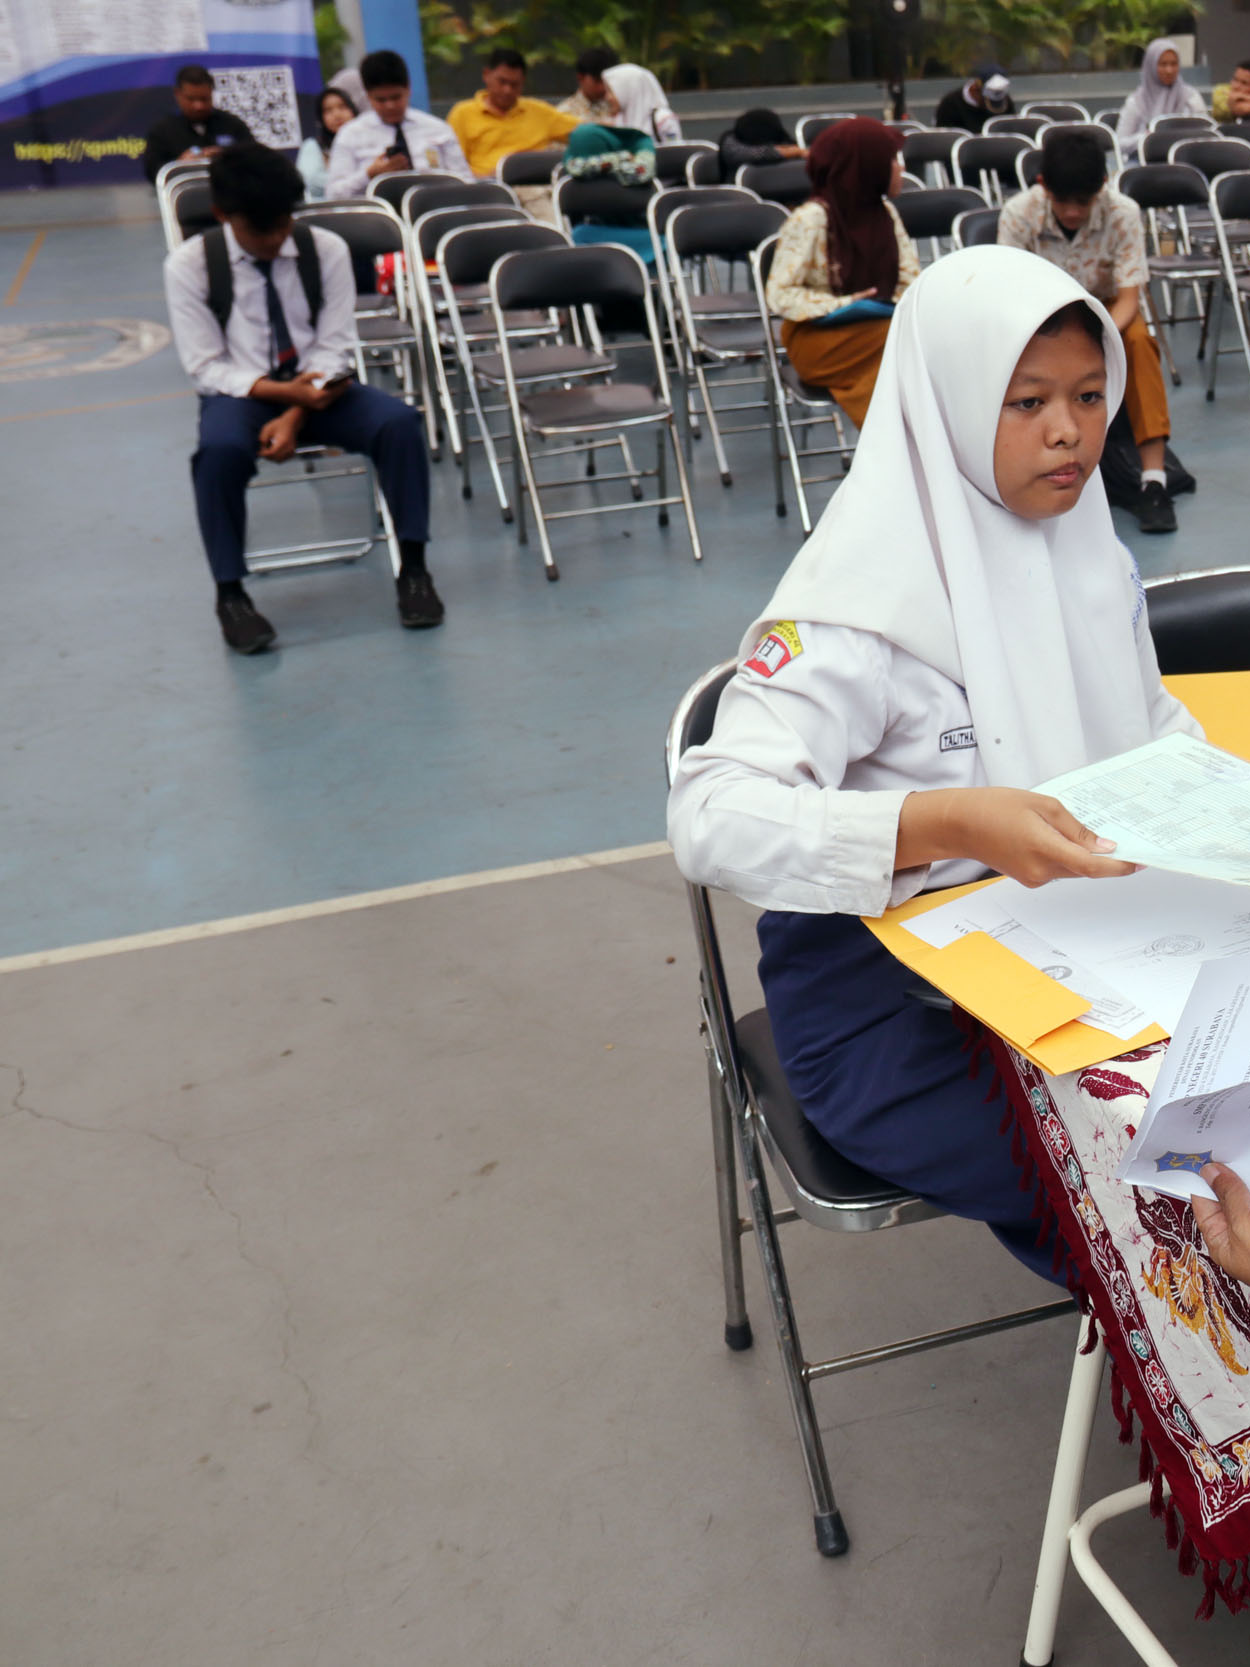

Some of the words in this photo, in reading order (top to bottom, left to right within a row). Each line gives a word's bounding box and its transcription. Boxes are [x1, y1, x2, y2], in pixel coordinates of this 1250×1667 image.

[1202, 1006, 1226, 1051] SURABAYA
[1199, 1050, 1208, 1061] 40
[1187, 1060, 1203, 1094] NEGERI
